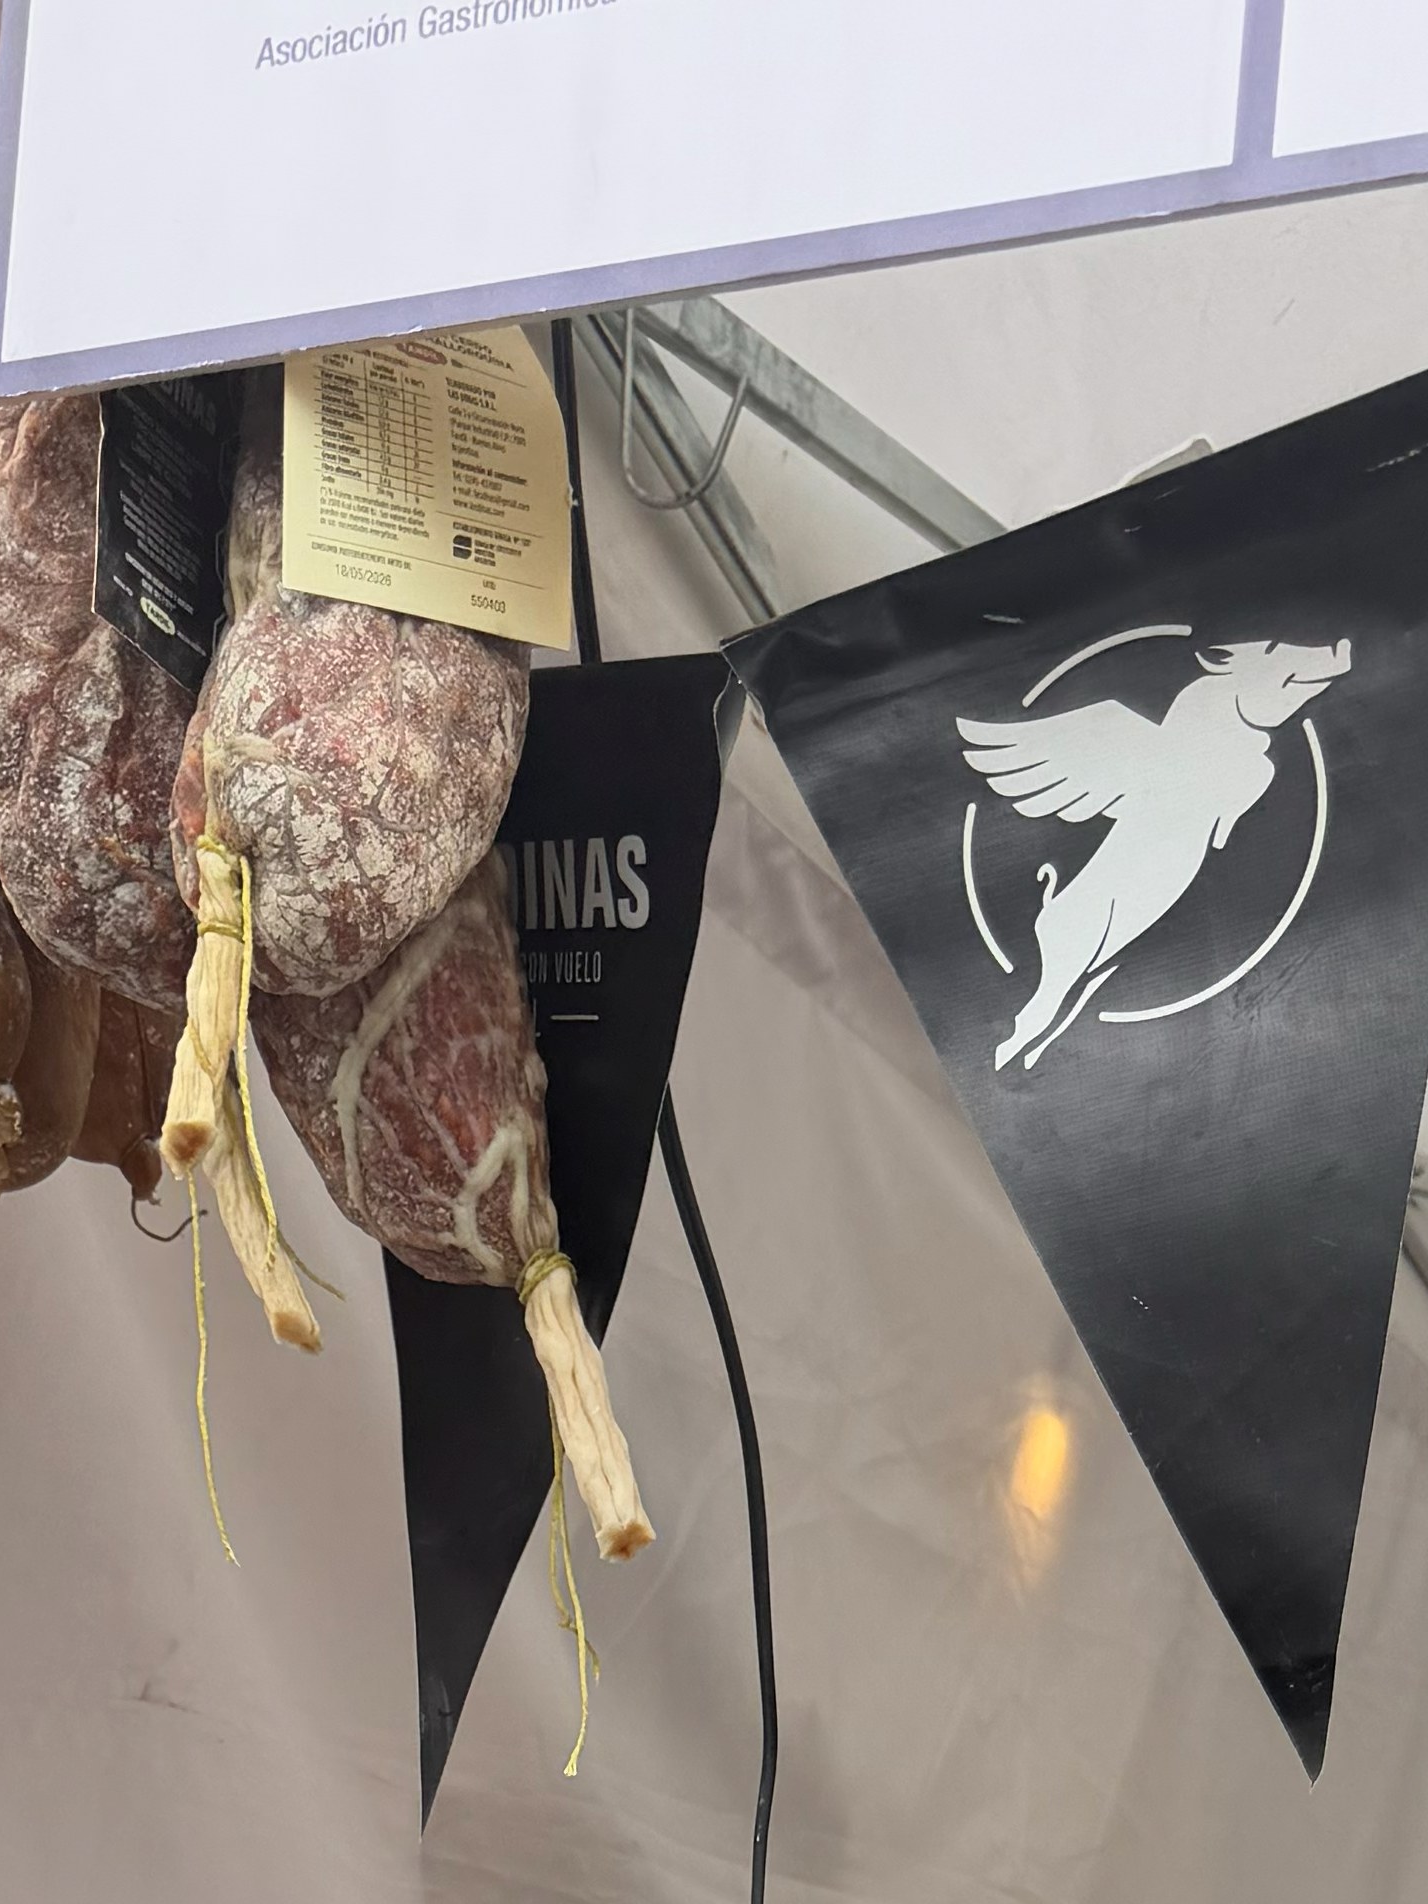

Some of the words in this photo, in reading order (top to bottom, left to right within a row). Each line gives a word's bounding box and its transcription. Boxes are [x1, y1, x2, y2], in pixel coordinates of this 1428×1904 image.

[255, 14, 407, 70] Asociación
[497, 835, 649, 929] INAS
[555, 951, 602, 983] VUELO
